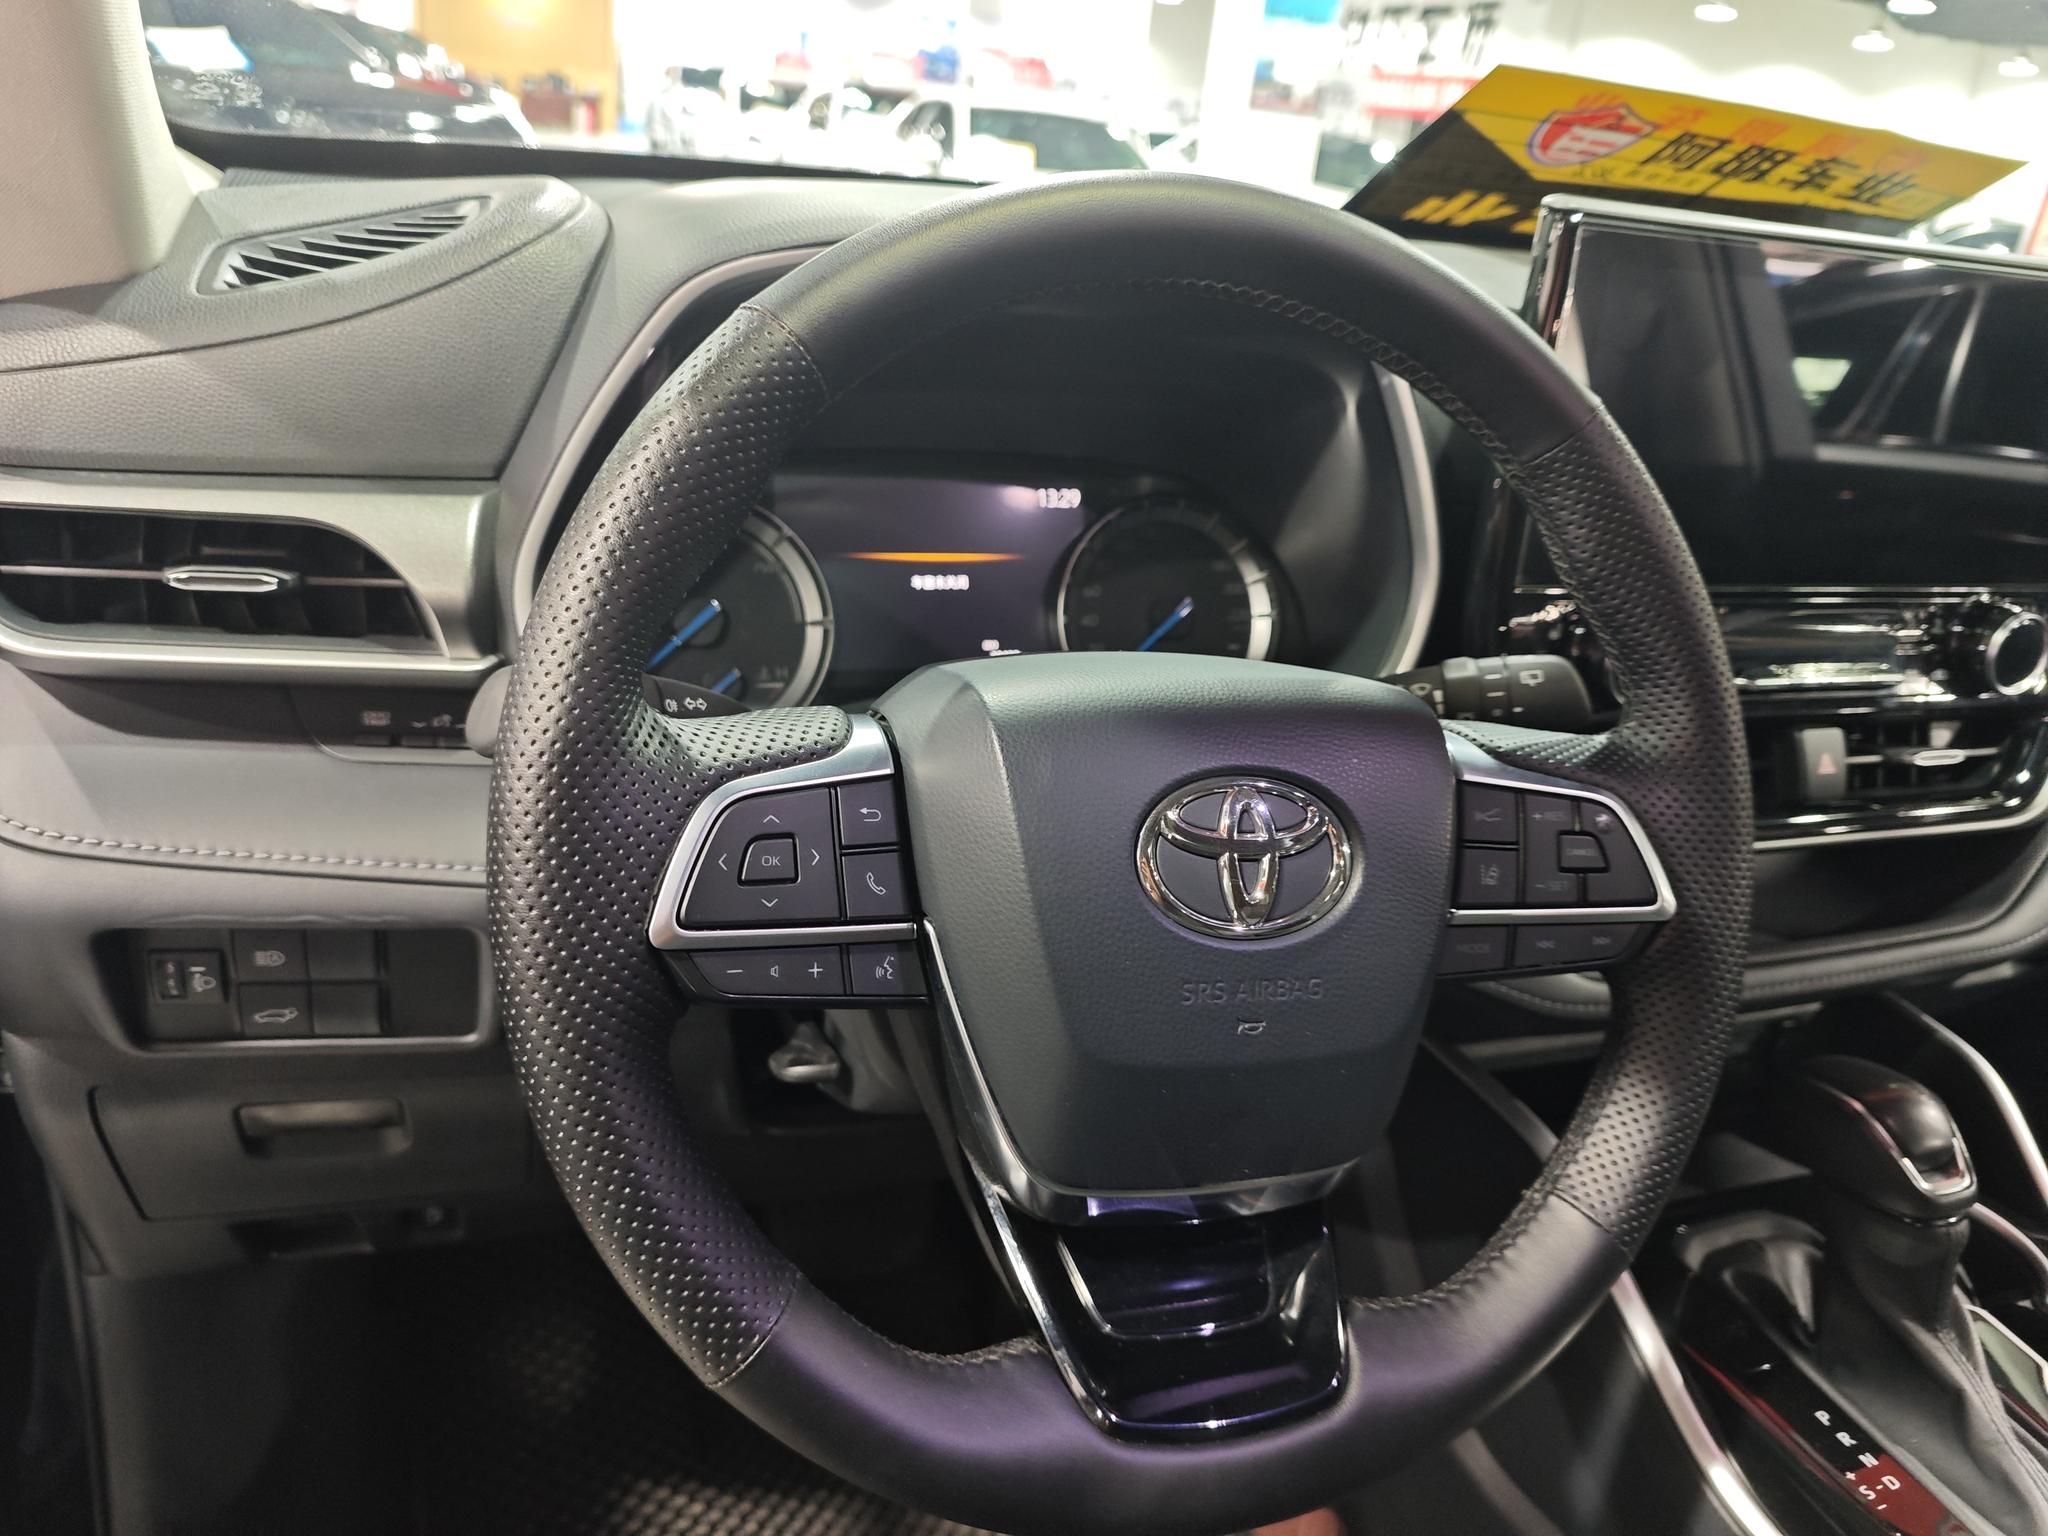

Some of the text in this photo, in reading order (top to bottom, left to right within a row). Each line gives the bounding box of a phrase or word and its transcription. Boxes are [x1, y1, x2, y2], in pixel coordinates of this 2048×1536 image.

[761, 855, 781, 867] OK
[1233, 976, 1323, 1002] AIRBAG
[1814, 1410, 1831, 1426] P
[1835, 1431, 1858, 1447] R
[1857, 1452, 1879, 1468] N
[1881, 1475, 1901, 1491] D
[1858, 1485, 1877, 1500] S
